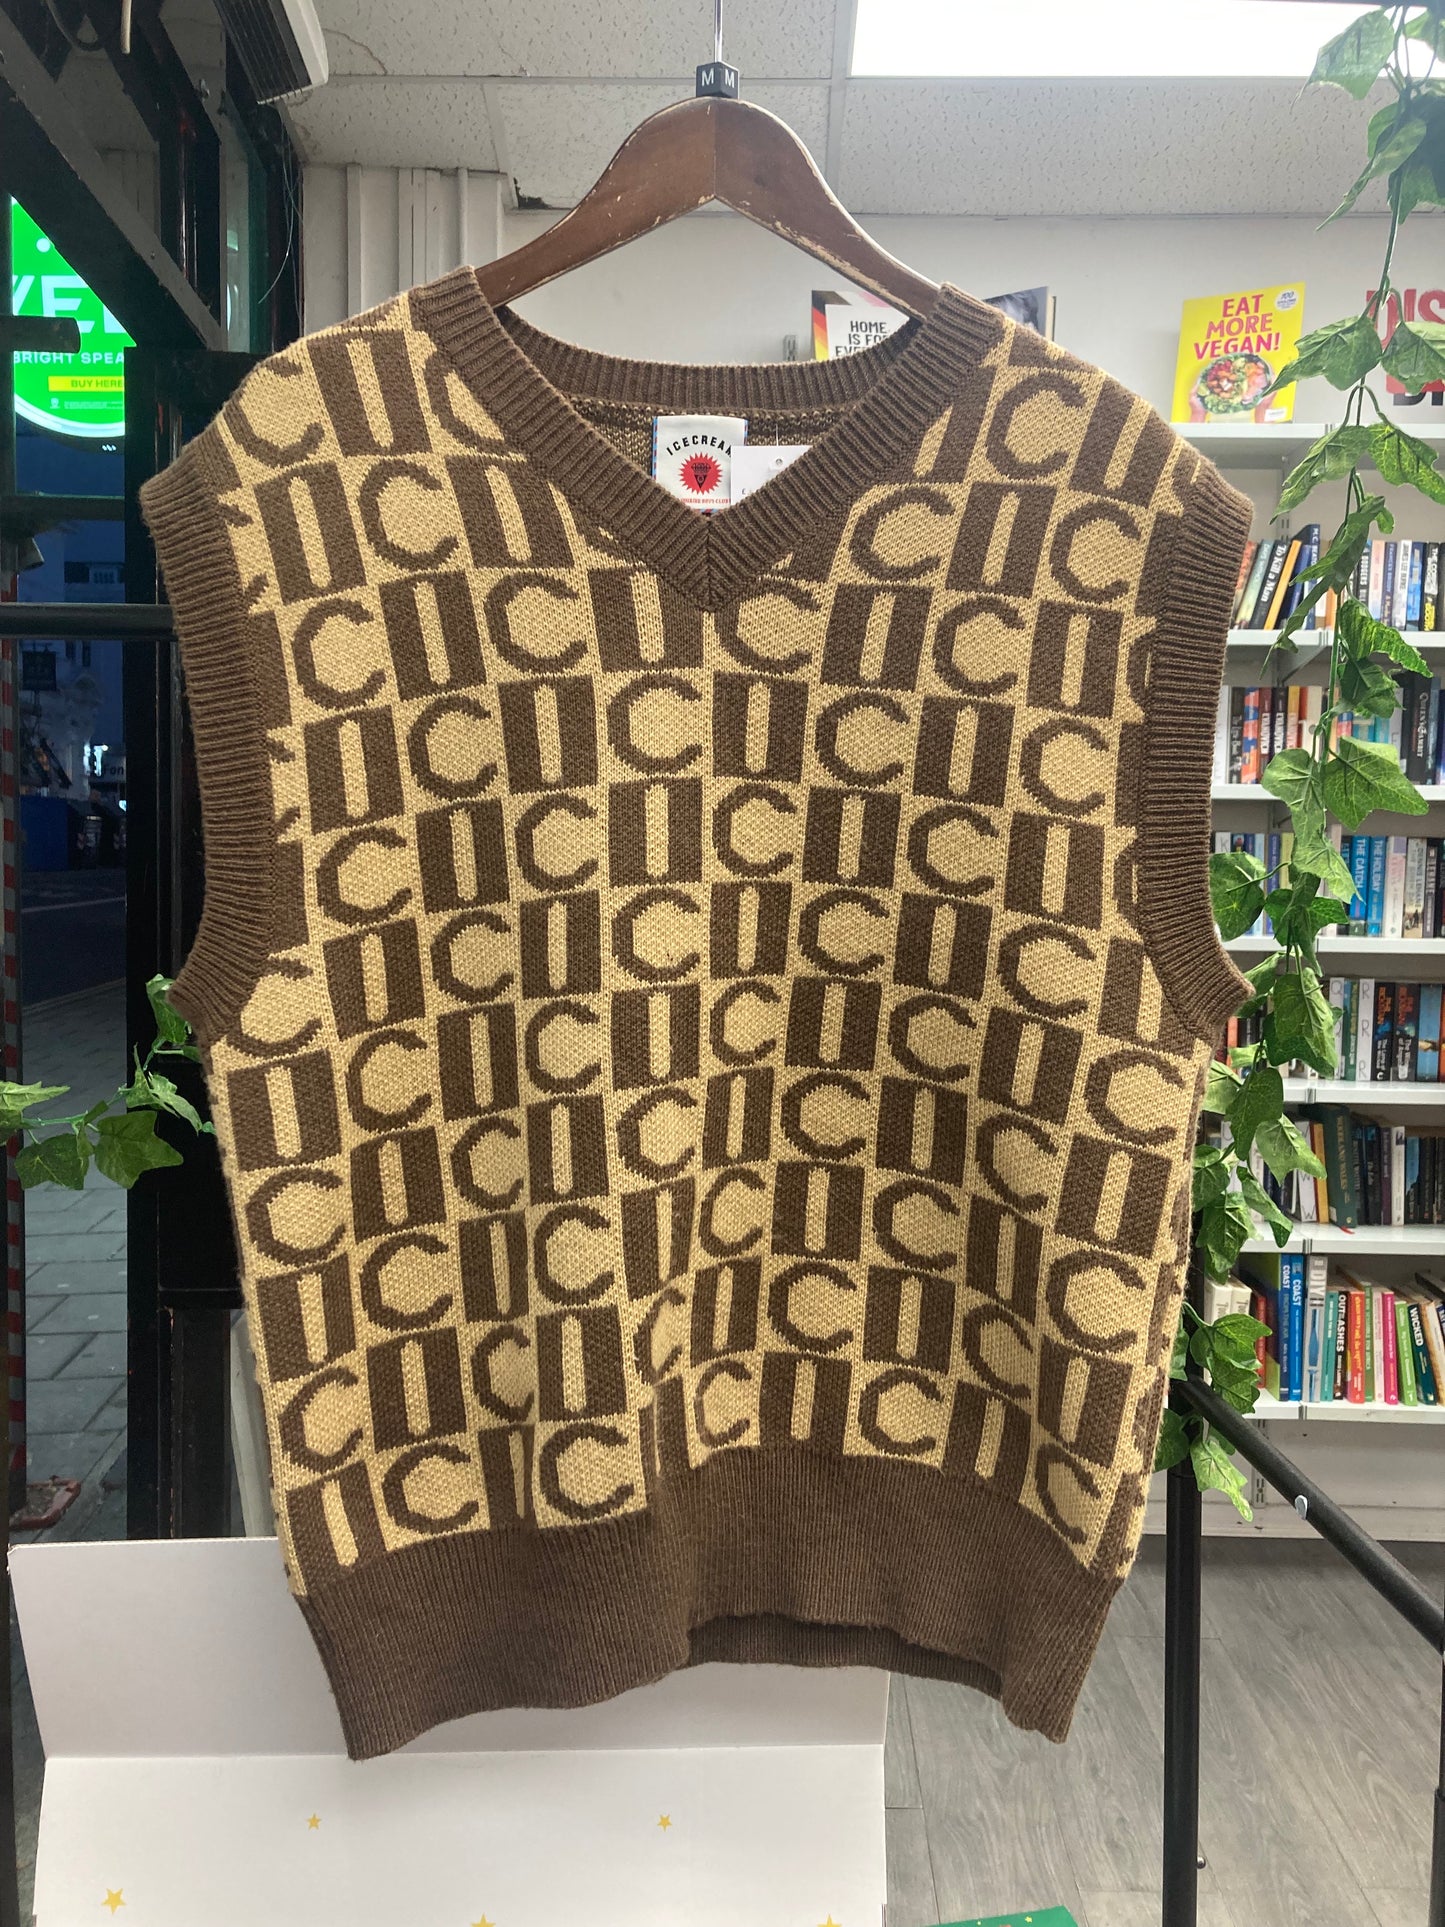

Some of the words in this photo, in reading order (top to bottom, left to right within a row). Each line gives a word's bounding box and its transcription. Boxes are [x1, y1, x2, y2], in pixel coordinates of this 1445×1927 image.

[702, 68, 714, 86] M
[725, 69, 734, 88] M
[1222, 294, 1264, 318] EAT
[850, 321, 887, 333] HOME
[1206, 313, 1273, 339] MORE
[848, 334, 860, 345] IS
[1194, 333, 1281, 360] VEGAN!
[15, 352, 73, 364] BRIGHT
[1276, 544, 1287, 556] To
[1270, 557, 1283, 572] Kill
[1261, 580, 1275, 602] Man
[1260, 713, 1269, 754] EVANOVICH
[1357, 839, 1366, 855] THE
[1374, 840, 1383, 855] THE
[1355, 858, 1366, 888] CATCH
[1372, 857, 1382, 892] HOLIDAY
[1362, 983, 1370, 1000] R
[1362, 1020, 1370, 1038] R
[1359, 1060, 1367, 1079] R
[1310, 1270, 1325, 1295] DIY
[1293, 1279, 1301, 1306] COAST
[1336, 1320, 1345, 1352] ASHES
[1410, 1307, 1424, 1346] WICKED
